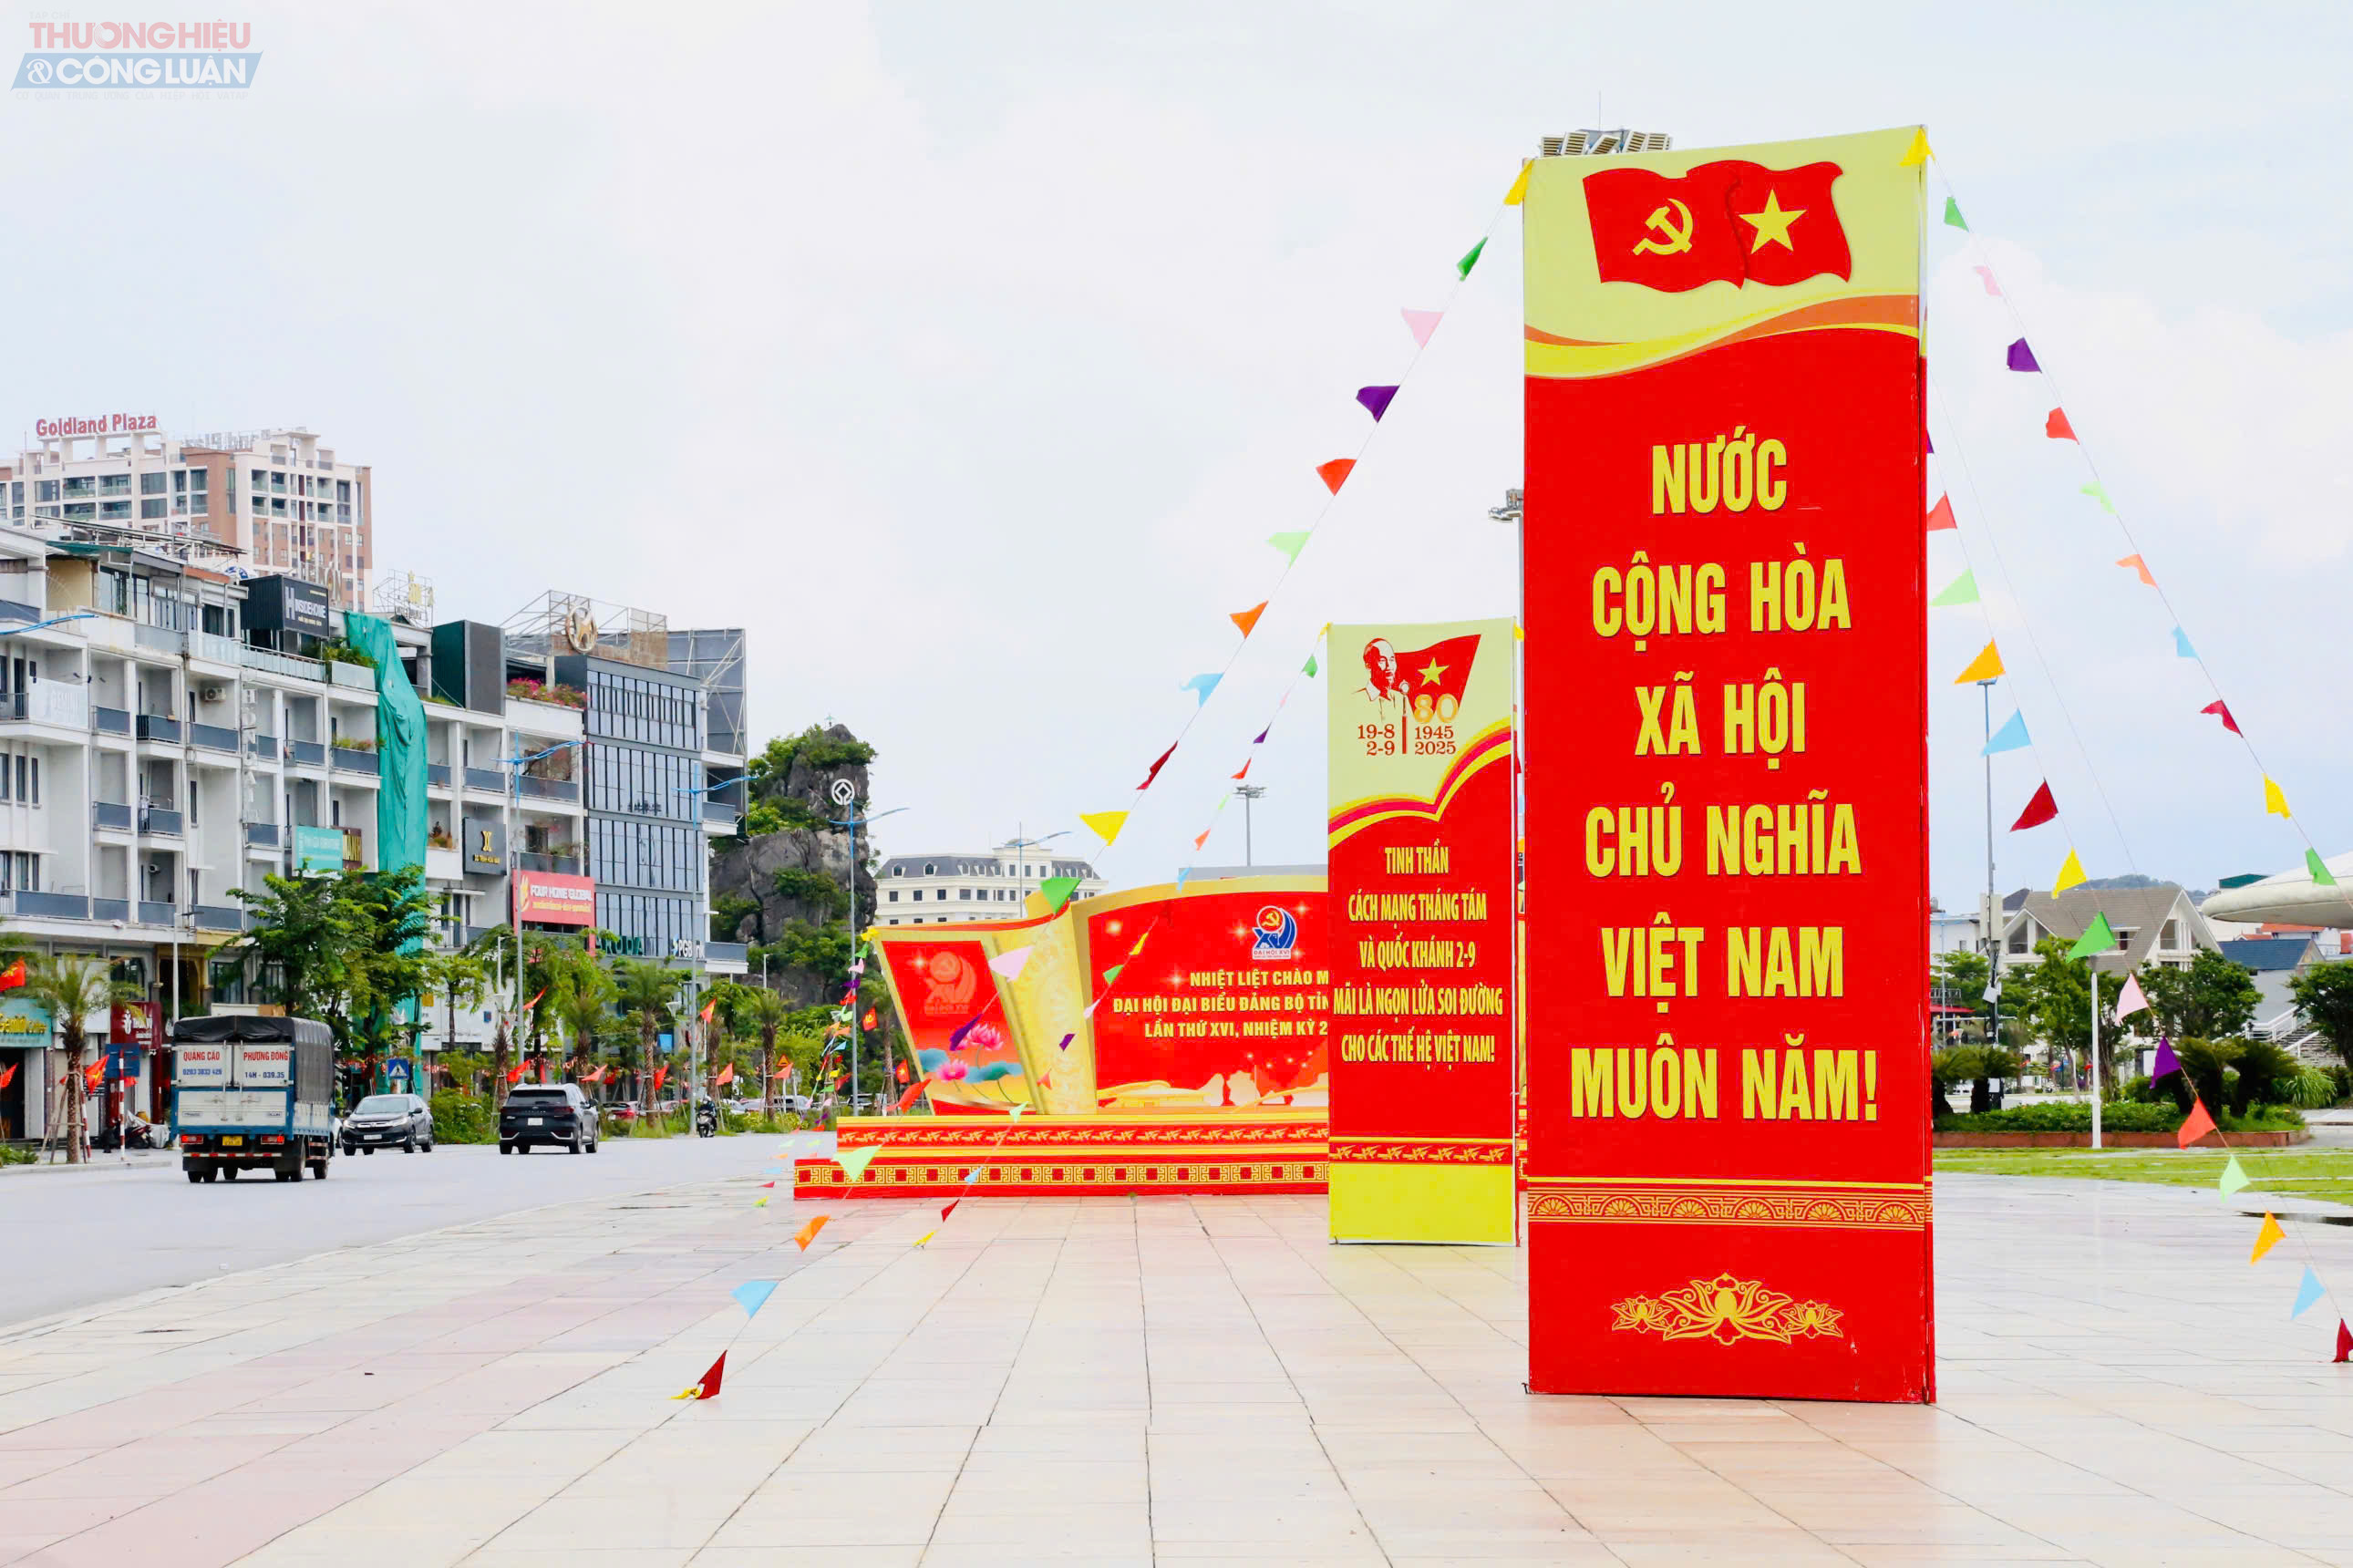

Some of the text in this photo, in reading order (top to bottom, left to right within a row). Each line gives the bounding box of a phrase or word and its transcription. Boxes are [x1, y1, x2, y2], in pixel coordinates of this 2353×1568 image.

[36, 413, 157, 437] Goldland Plaza
[1653, 426, 1786, 513] NƯỚC
[1594, 542, 1851, 651] CỘNG HÒA
[1414, 693, 1459, 723] 80
[1636, 667, 1805, 769] XÃ HỘI
[1358, 724, 1395, 738] 19-8
[1367, 740, 1396, 756] 2-9
[1415, 726, 1454, 739] 1945
[1415, 741, 1456, 755] 2025
[1586, 782, 1861, 877] CHỦ NGHĨA
[1385, 839, 1449, 873] TINH THẦN
[1348, 888, 1486, 928] CÁCH MẠNG THÁNG TÁM
[678, 939, 705, 959] PGBnk
[1359, 932, 1475, 971] VÀ QUỐC KHÁNH 2-9
[1602, 912, 1842, 1013] VIỆT NAM
[1191, 969, 1234, 989] NHIỆT
[1238, 969, 1269, 988] LIỆT
[1273, 968, 1312, 985] CHÀO
[1113, 998, 1139, 1016] ĐẠI
[1143, 995, 1167, 1015] HỘI
[1171, 997, 1196, 1015] ĐẠI
[1202, 992, 1235, 1011] BIỂU
[1239, 992, 1280, 1011] ĐẢNG
[1285, 993, 1304, 1013] BỘ
[1334, 979, 1502, 1022] MÃI LÀ NGỌN LỬA SOI ĐƯỜNG
[1145, 1018, 1174, 1037] LẦN
[1178, 1020, 1207, 1037] THỨ
[1211, 1023, 1239, 1037] XVI,
[1244, 1019, 1292, 1038] NHIỆM
[1296, 1018, 1315, 1035] KỲ
[1342, 1026, 1494, 1069] CHO CÁC THẾ HỆ VIỆT NAM!
[1572, 1033, 1876, 1120] MUÔN NĂM!
